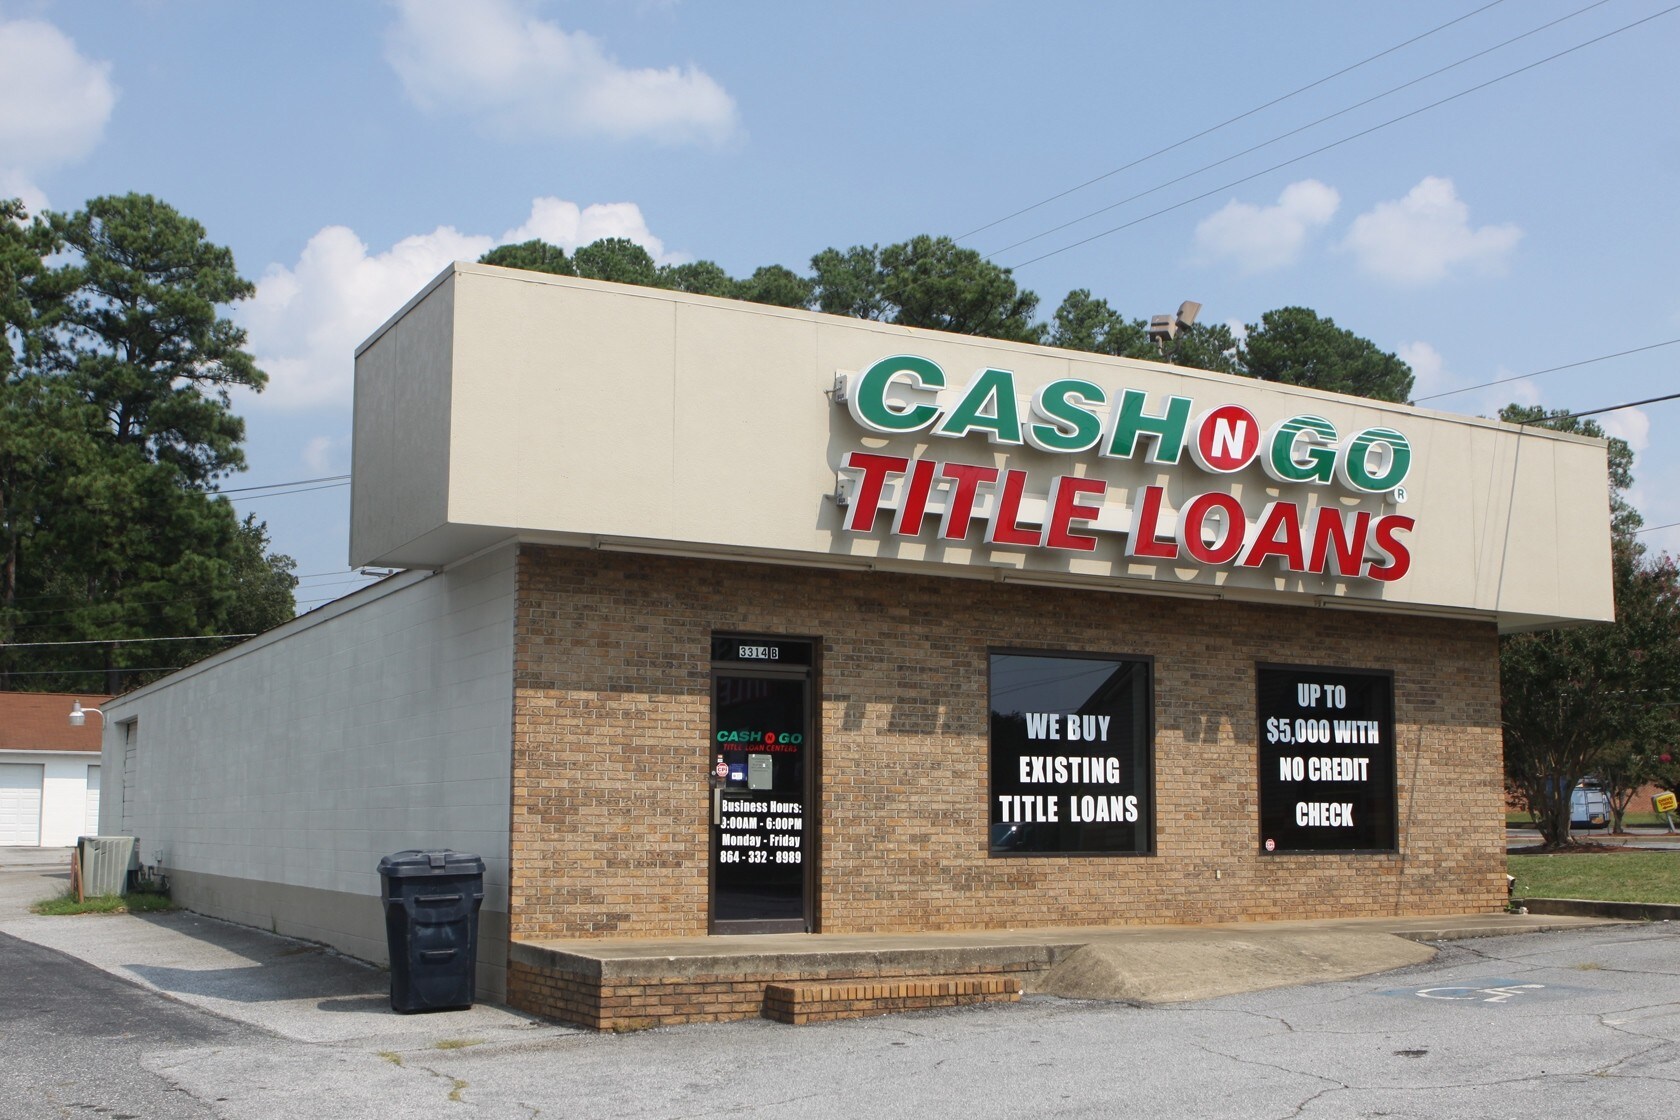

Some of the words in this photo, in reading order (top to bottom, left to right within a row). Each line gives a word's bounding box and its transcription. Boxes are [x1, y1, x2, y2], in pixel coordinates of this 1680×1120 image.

[854, 353, 1194, 466] CASH
[1210, 417, 1247, 460] N
[1268, 414, 1413, 494] GO
[848, 451, 1108, 553] TITLE
[1132, 485, 1416, 583] LOANS
[740, 646, 768, 658] 3314
[771, 648, 778, 658] B
[1297, 683, 1321, 708] UP
[1324, 684, 1346, 709] TO
[716, 730, 762, 742] CASH
[778, 732, 803, 744] GO
[1025, 712, 1060, 740] WE
[1067, 714, 1111, 741] BUY
[1266, 716, 1330, 745] $5,000
[1333, 719, 1380, 744] WITH
[723, 743, 742, 752] TITLE
[745, 744, 765, 752] LOAN
[766, 744, 798, 753] CENTERS
[1019, 756, 1120, 783] EXISTING
[1279, 757, 1304, 781] NO
[1308, 757, 1369, 781] CREDIT
[722, 799, 768, 813] Business
[770, 800, 802, 814] Hours:
[999, 795, 1059, 823] TITLE
[1070, 795, 1138, 823] LOANS
[1295, 802, 1354, 827] CHECK
[766, 817, 803, 830] 6:00PM
[721, 833, 761, 848] Monday
[769, 834, 800, 848] Friday
[720, 850, 740, 863] 864
[748, 850, 768, 863] 332
[775, 850, 802, 864] 8989
